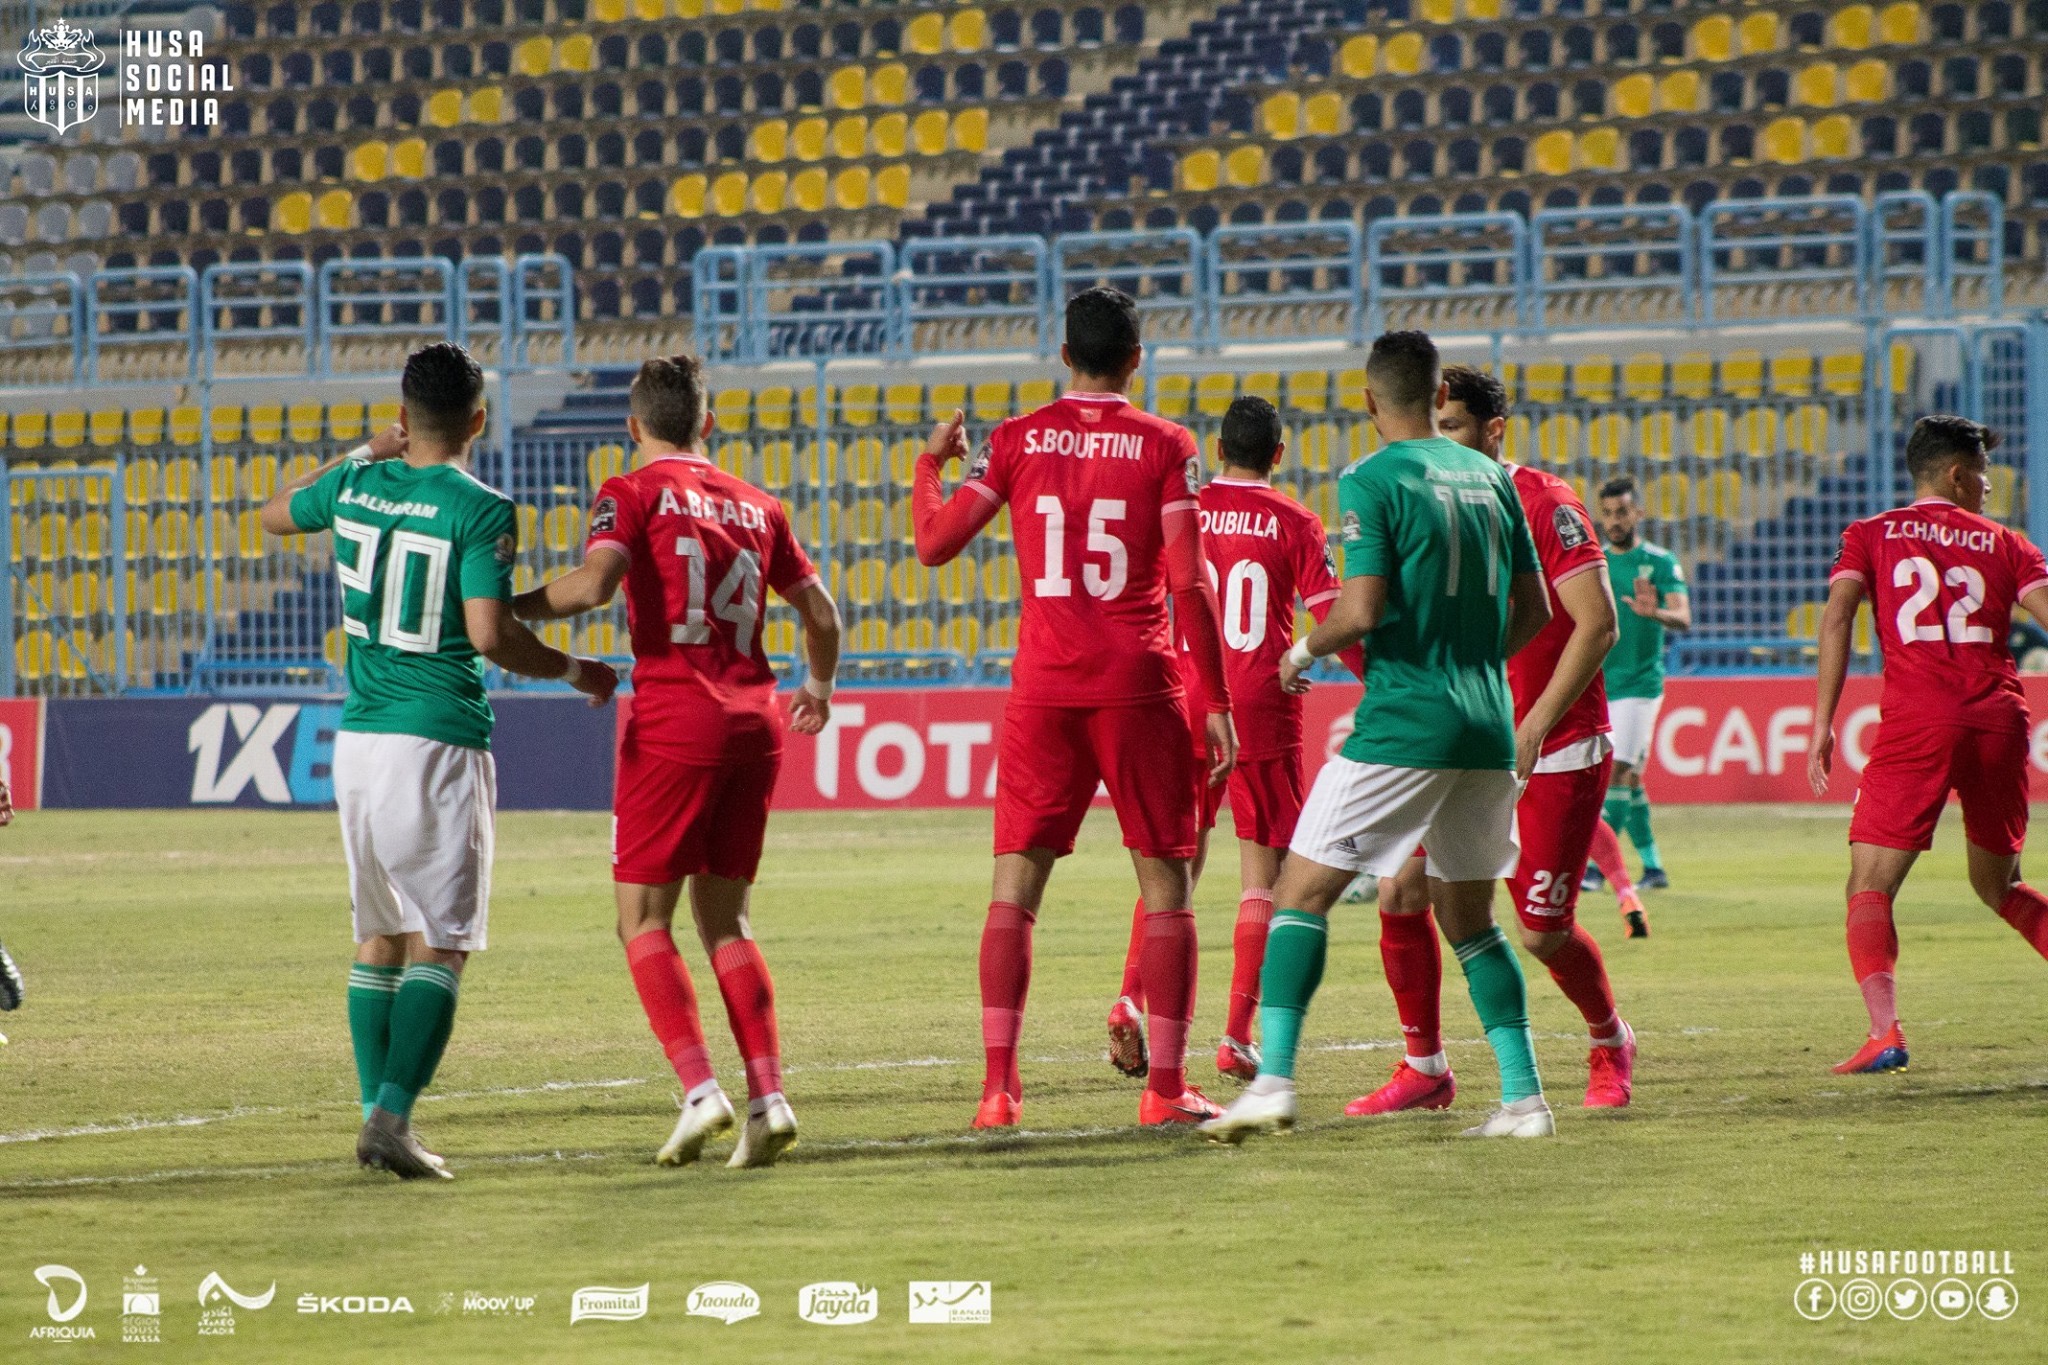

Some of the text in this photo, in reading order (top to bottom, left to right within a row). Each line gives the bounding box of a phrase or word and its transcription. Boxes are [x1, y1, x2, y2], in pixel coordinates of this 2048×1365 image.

[1024, 428, 1144, 460] S.BOUFTINI
[1034, 495, 1128, 601] 15
[1432, 486, 1500, 597] 17
[1884, 520, 1996, 554] Z.CHAOUCH
[333, 515, 453, 654] 20
[670, 537, 761, 658] 14
[1893, 557, 1994, 645] 22
[1656, 705, 1814, 776] CAF
[1526, 870, 1572, 906] 26
